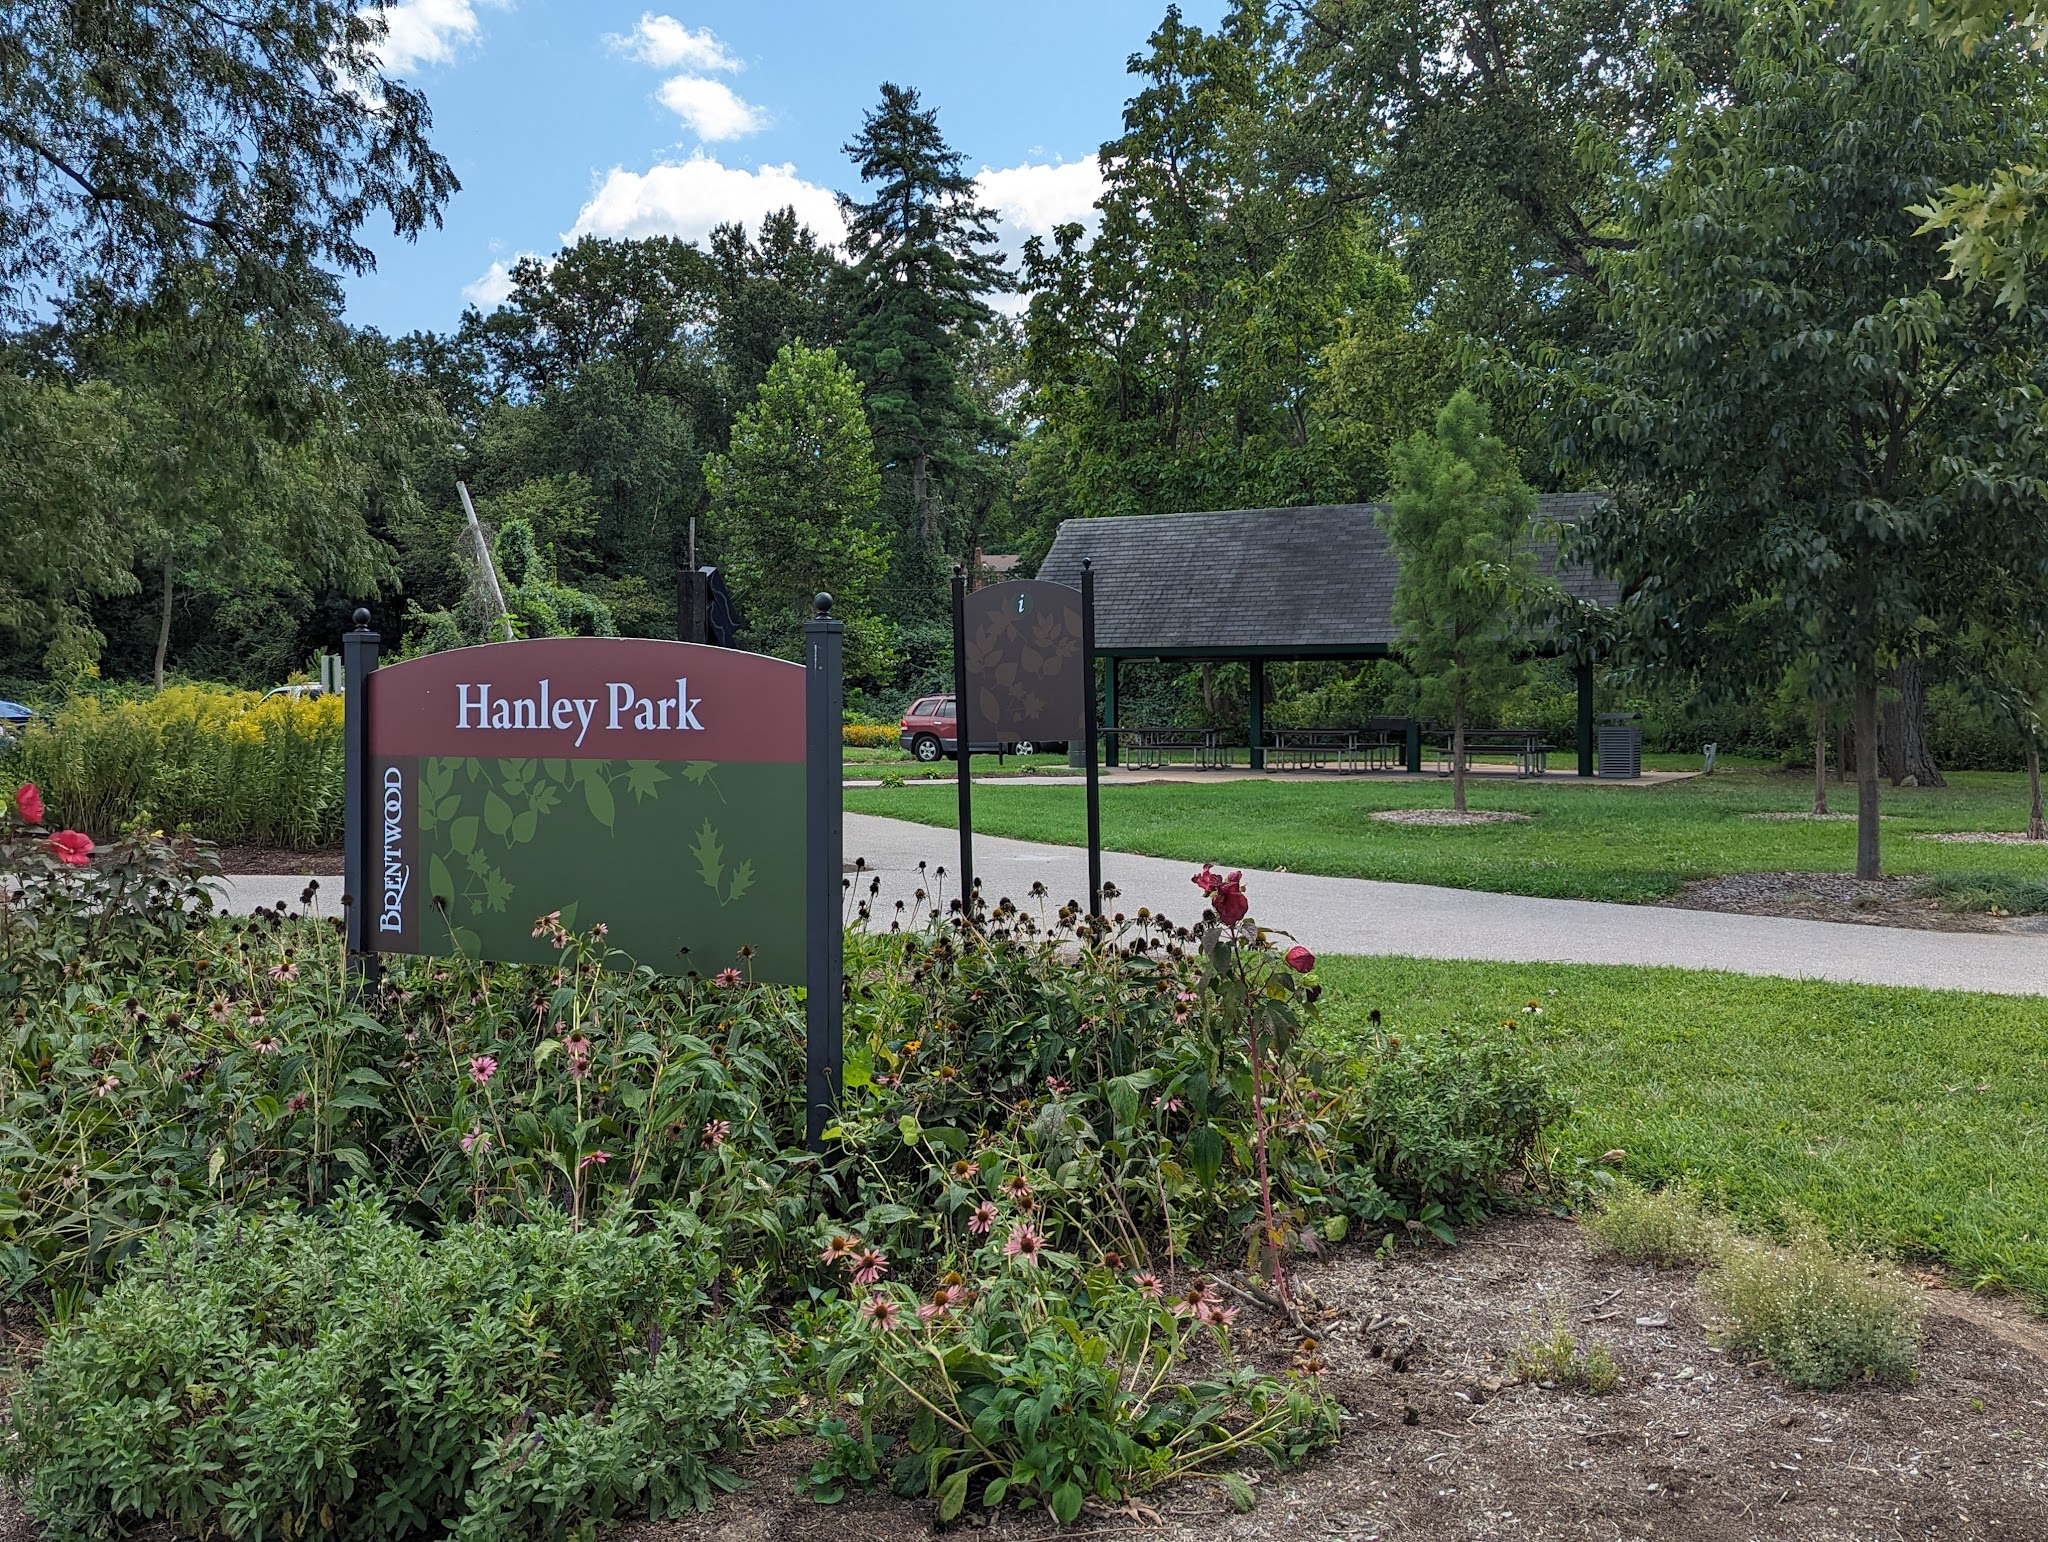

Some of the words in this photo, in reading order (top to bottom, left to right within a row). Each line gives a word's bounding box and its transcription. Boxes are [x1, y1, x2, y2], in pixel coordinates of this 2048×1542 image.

[1017, 594, 1025, 613] i
[455, 678, 599, 748] Hanley
[605, 677, 705, 731] Park
[379, 766, 410, 934] BRENTWOOD
